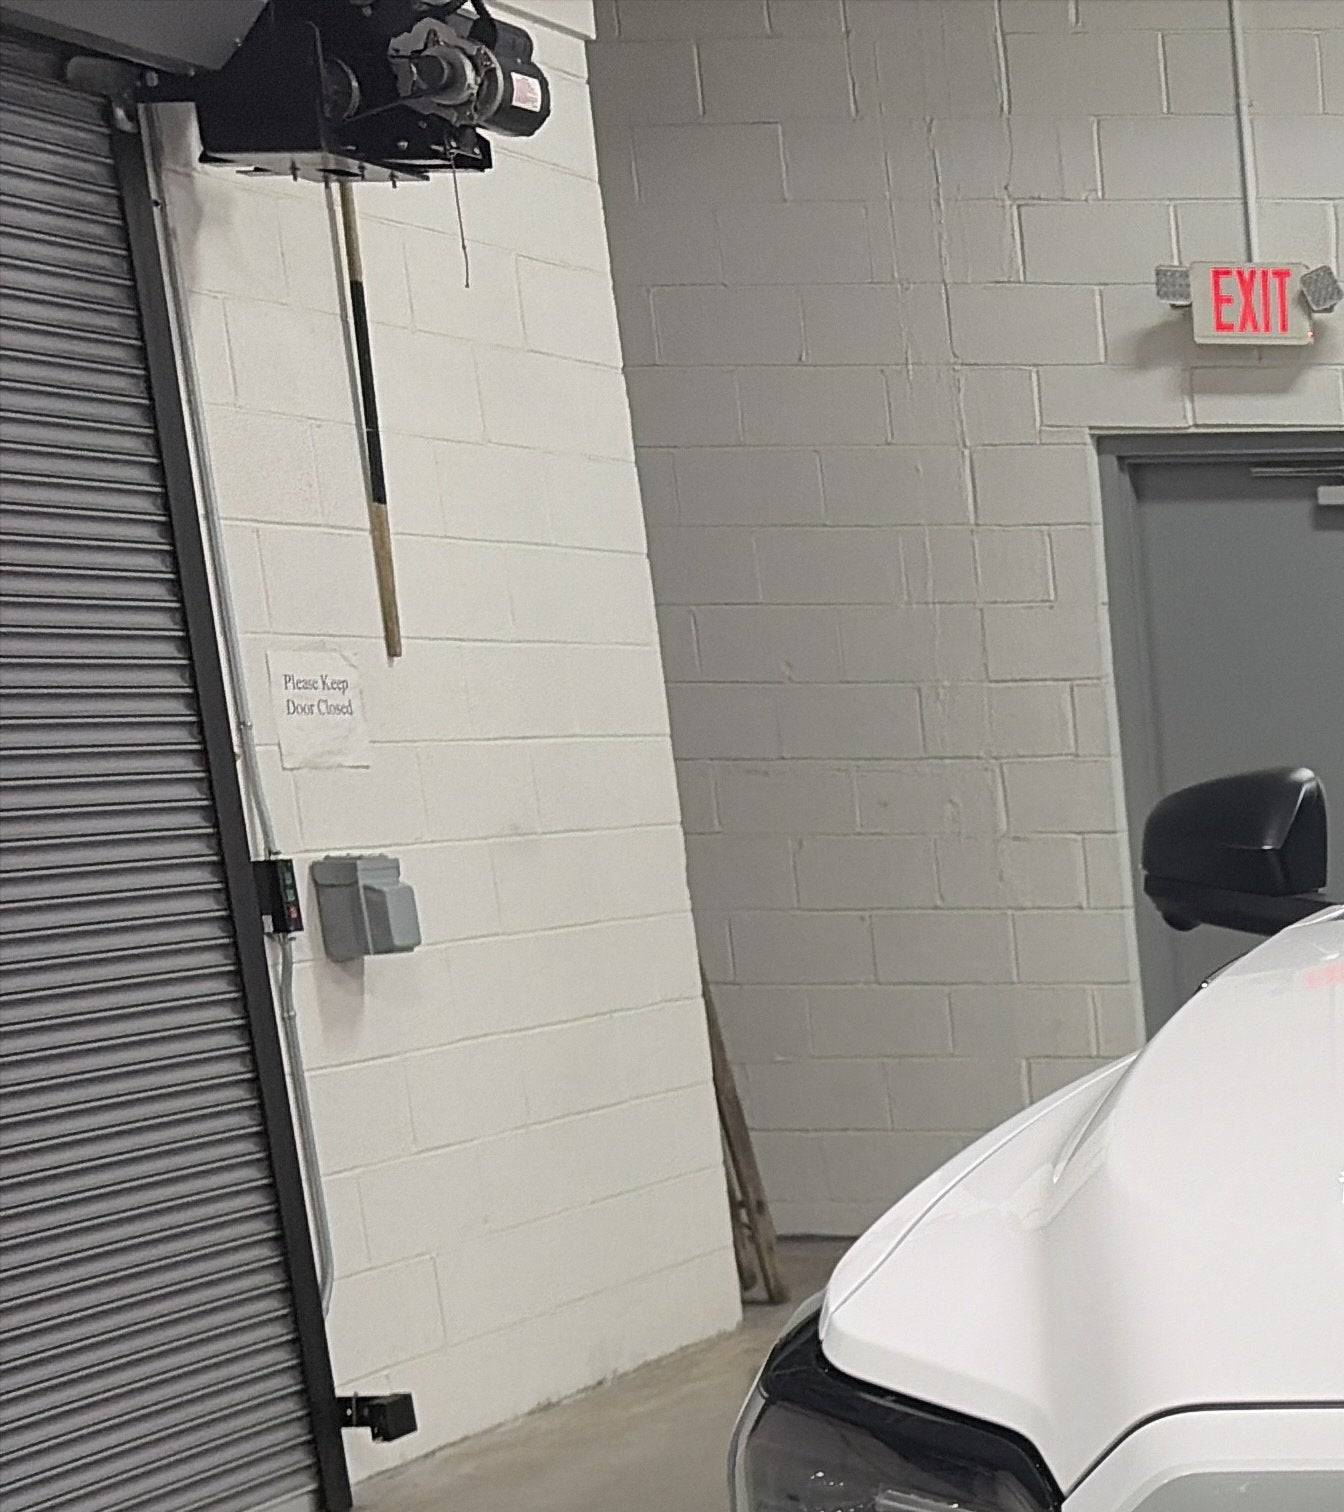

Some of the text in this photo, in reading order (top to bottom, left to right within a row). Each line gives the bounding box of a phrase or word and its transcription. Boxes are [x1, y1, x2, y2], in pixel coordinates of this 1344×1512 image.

[1210, 267, 1291, 333] EXIT
[283, 673, 349, 695] Please Keep
[286, 698, 353, 716] Door Closed
